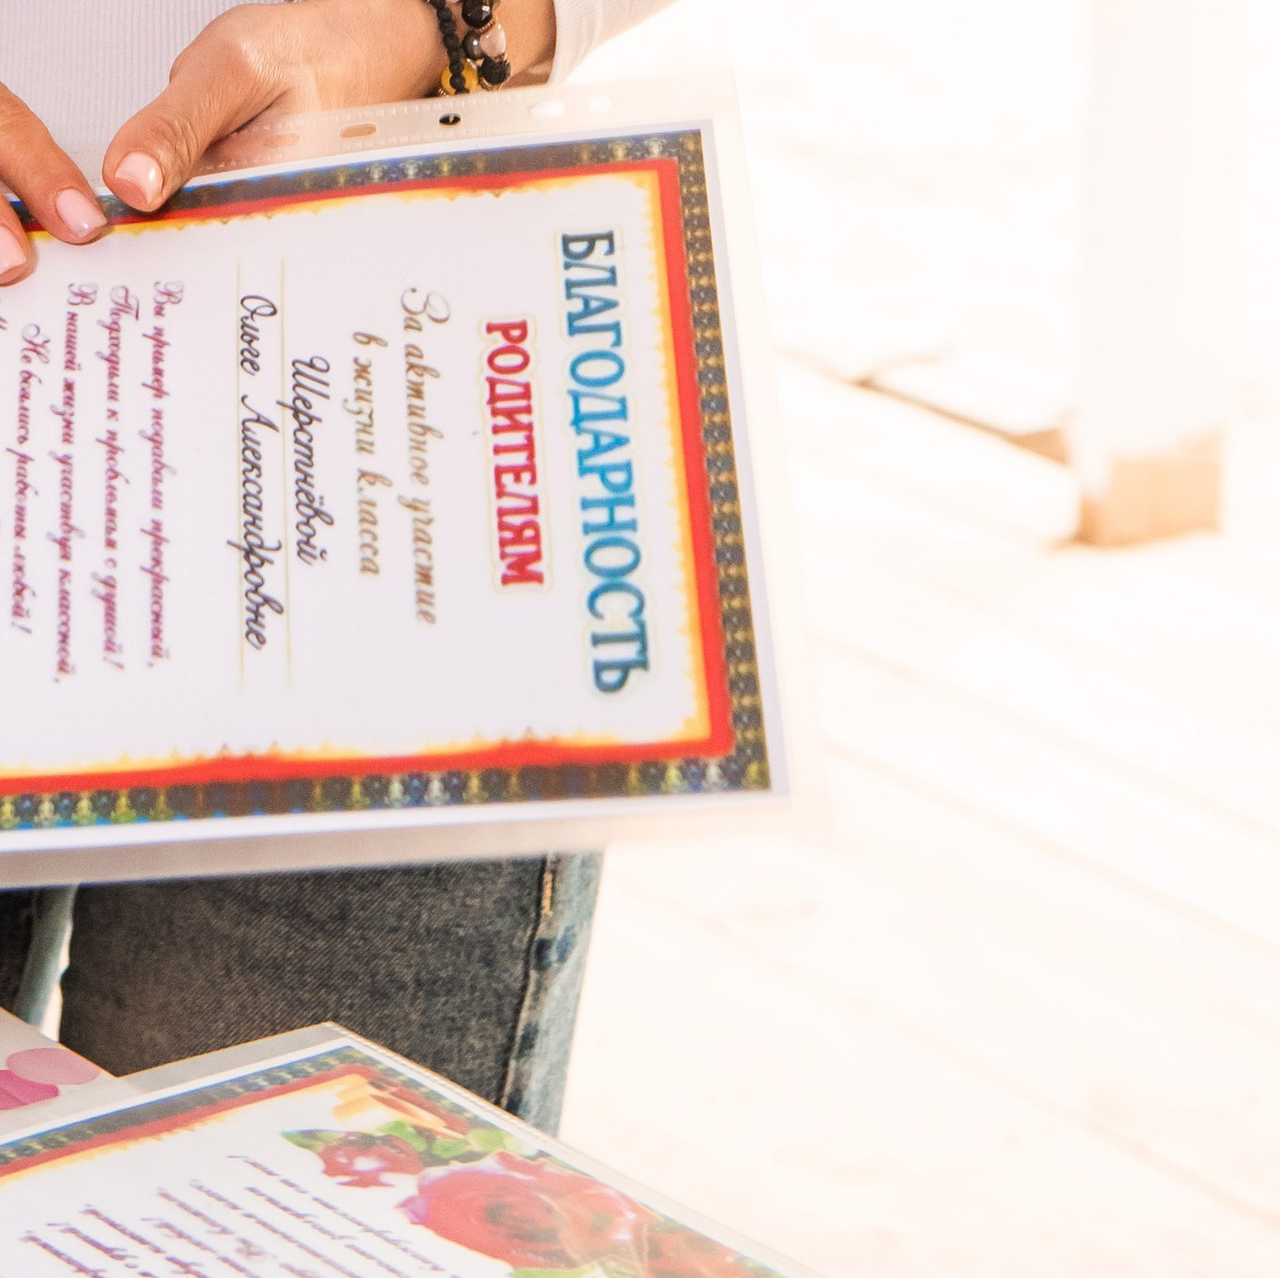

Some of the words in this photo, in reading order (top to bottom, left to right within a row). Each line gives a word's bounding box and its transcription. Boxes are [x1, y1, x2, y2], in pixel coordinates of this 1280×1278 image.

[66, 283, 98, 306] В
[152, 281, 183, 317] Вы
[238, 294, 276, 376] Ольге
[351, 332, 387, 348] в
[400, 287, 450, 332] За
[20, 324, 50, 364] Не
[63, 311, 81, 371] нашей
[94, 285, 138, 402] Подходили
[141, 326, 169, 399] пример
[16, 370, 41, 445] боялись
[49, 378, 75, 445] жизни
[105, 409, 117, 421] к
[342, 356, 377, 454] жизни
[403, 344, 443, 485] активное
[5, 448, 39, 540] работы
[94, 430, 129, 550] проблемам
[138, 408, 176, 509] подавали
[275, 356, 333, 566] Шерстнёвой
[484, 320, 544, 586] РОДИТЕЛЯМ
[561, 230, 649, 693] БЛАГОДАРНОСТЬ
[45, 451, 84, 561] участвуя
[226, 394, 284, 650] Александровне
[356, 468, 391, 576] класса
[10, 545, 36, 634] любой!
[104, 558, 117, 568] с
[397, 497, 436, 624] участие
[90, 575, 124, 669] душой!
